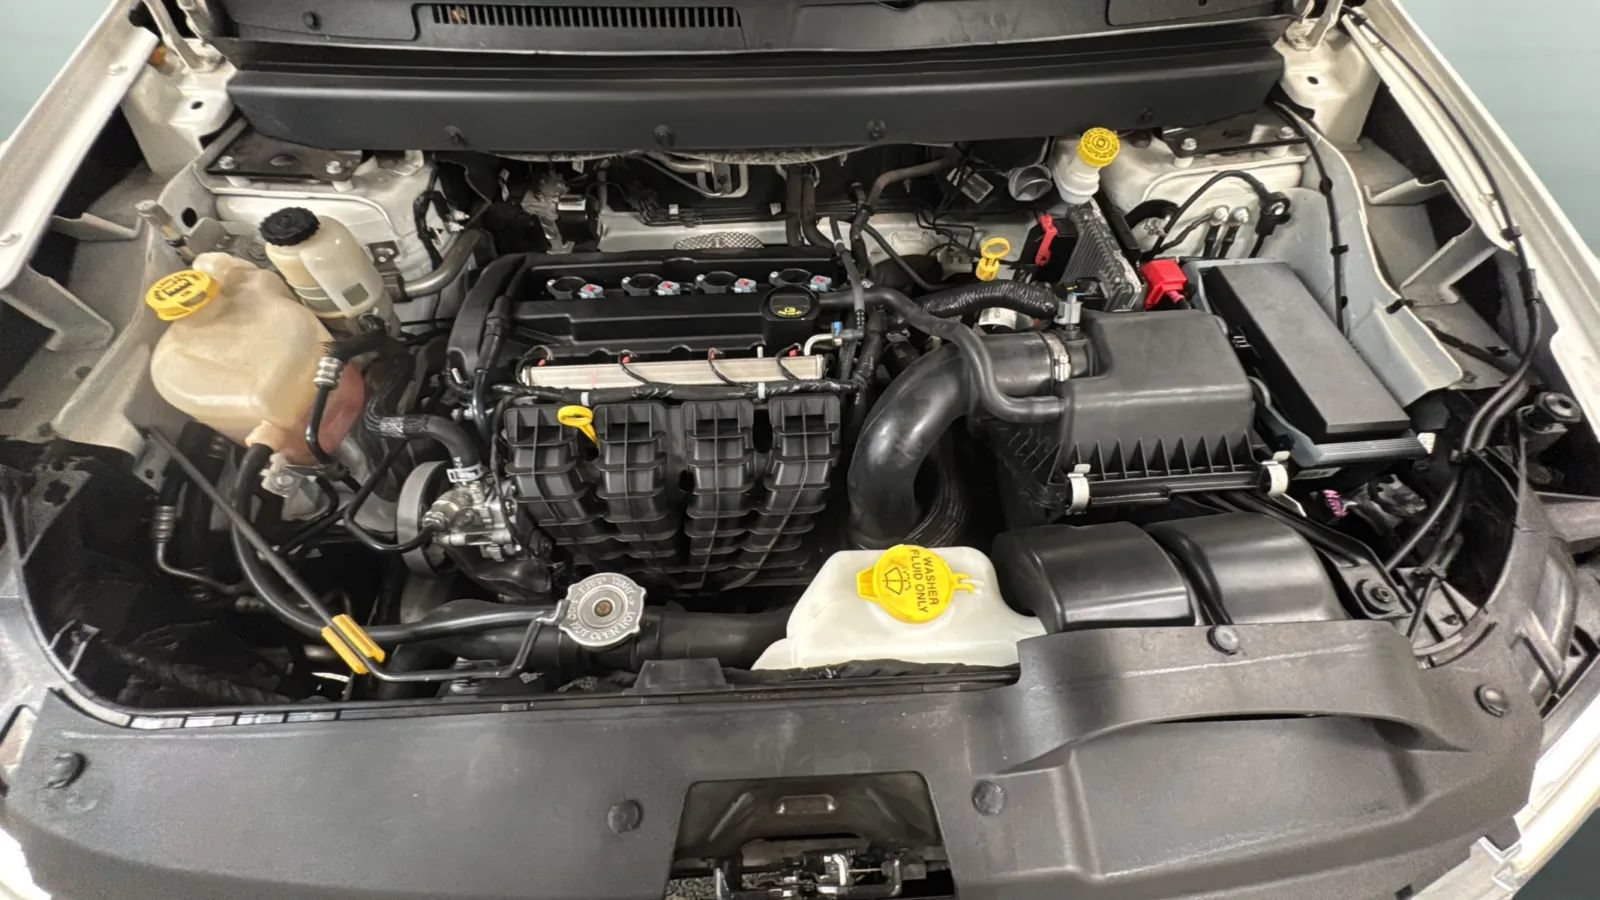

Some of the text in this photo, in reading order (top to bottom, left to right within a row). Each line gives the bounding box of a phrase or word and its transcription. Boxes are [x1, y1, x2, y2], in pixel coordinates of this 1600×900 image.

[910, 549, 929, 613] FLUID ONLY
[923, 557, 940, 605] WASHER
